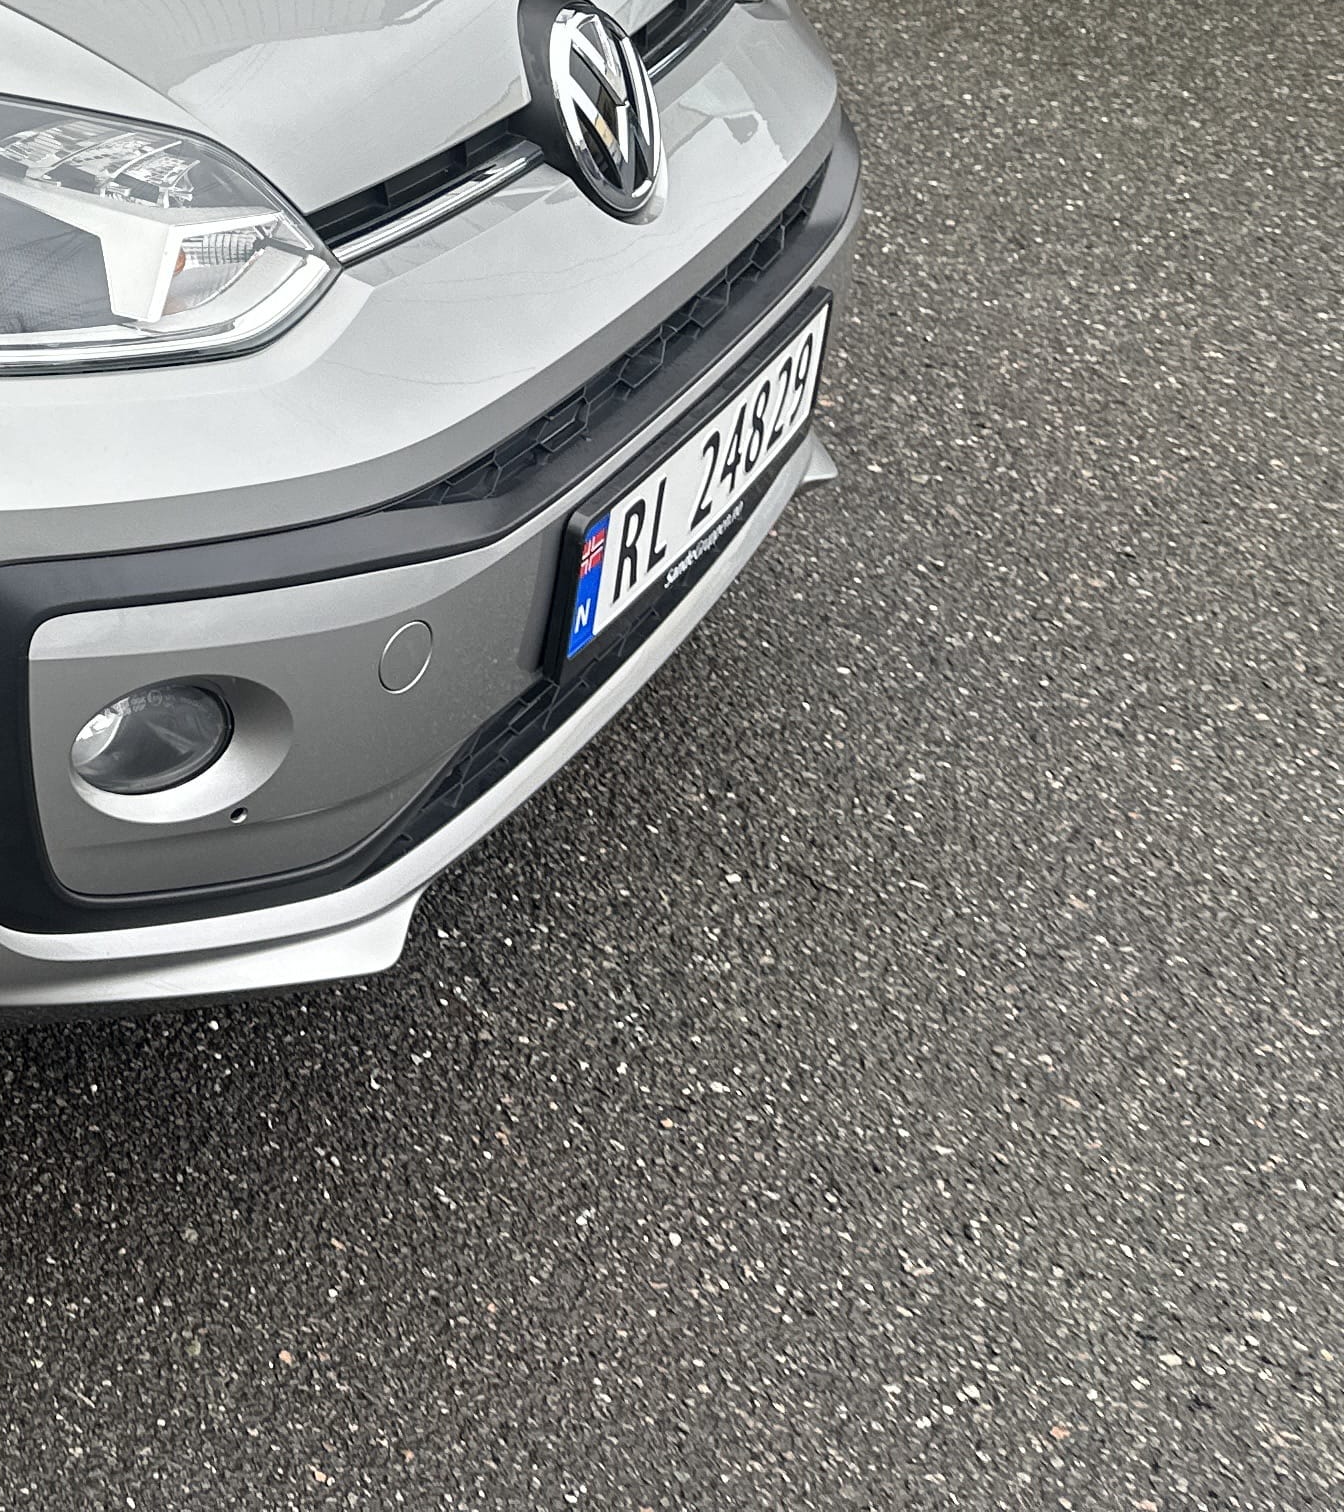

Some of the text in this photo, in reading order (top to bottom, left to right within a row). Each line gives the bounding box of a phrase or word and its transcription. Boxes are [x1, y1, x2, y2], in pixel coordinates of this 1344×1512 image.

[612, 476, 667, 604] RL
[690, 333, 813, 531] 24829
[574, 599, 590, 633] N
